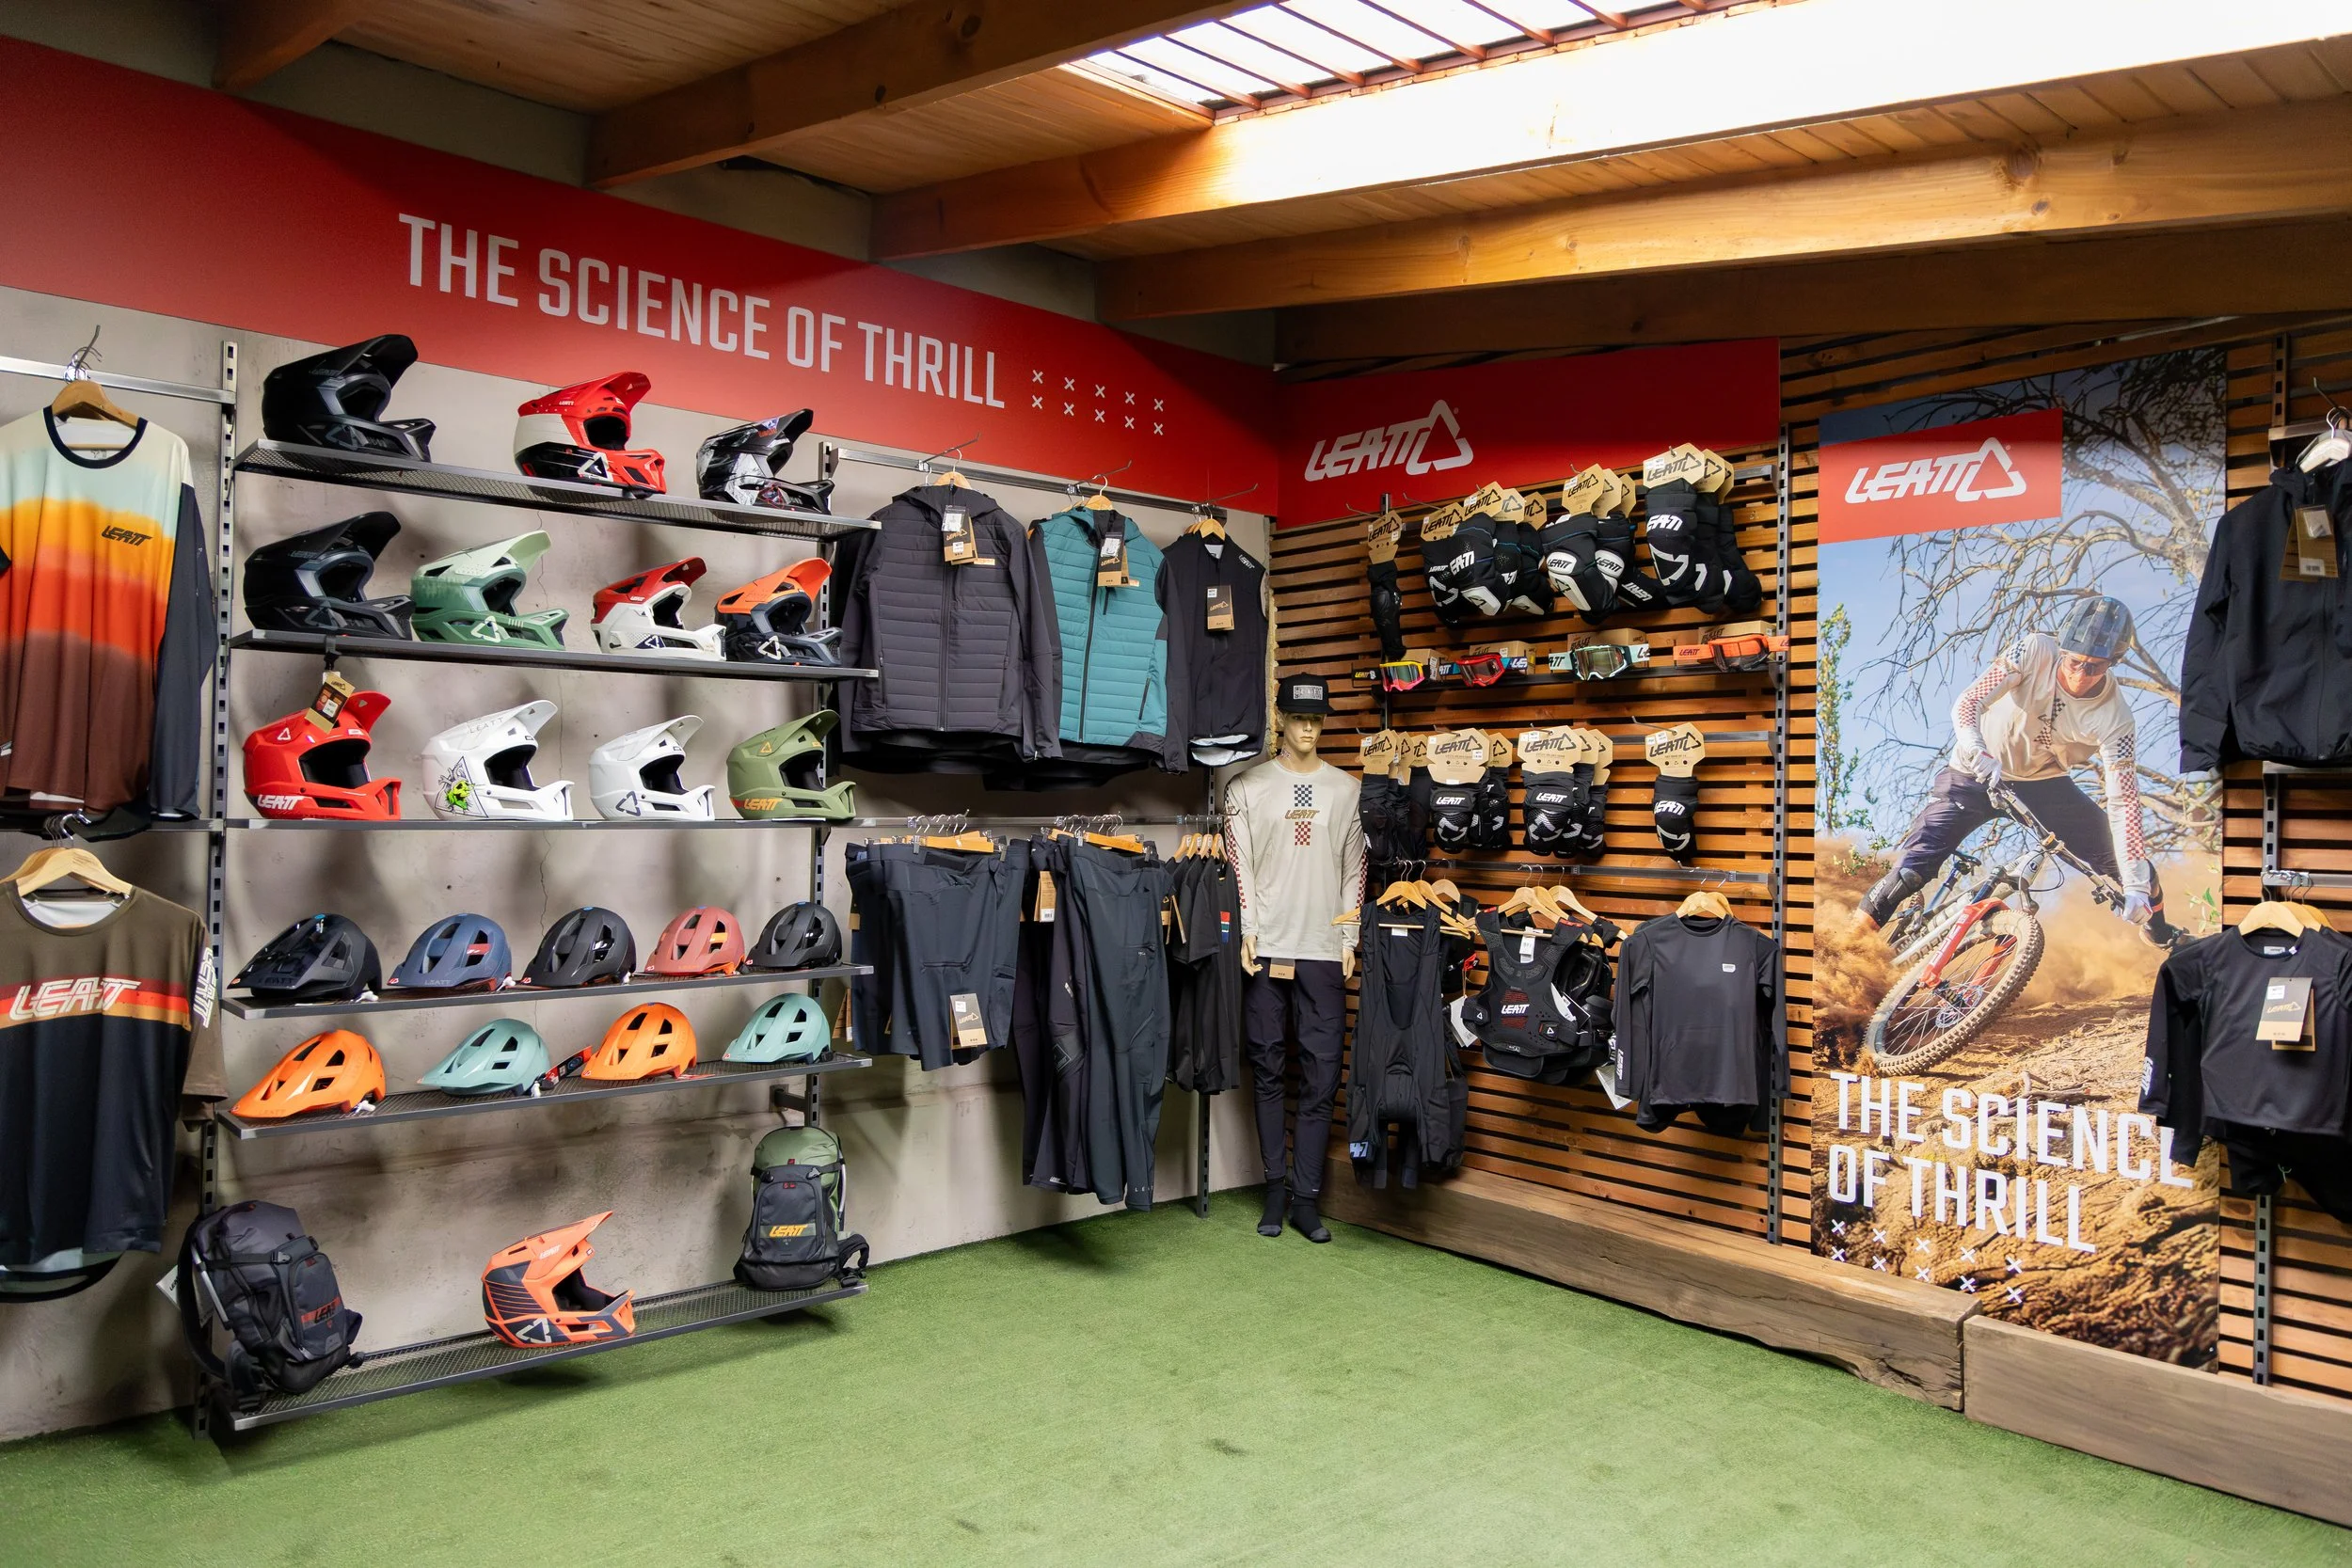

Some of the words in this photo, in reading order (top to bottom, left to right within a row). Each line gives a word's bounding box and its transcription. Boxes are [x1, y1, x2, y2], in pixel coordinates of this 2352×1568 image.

[399, 213, 518, 308] THE
[539, 248, 770, 360] SCIENCE
[787, 306, 846, 372] OF
[857, 322, 1005, 408] THRILL
[1305, 414, 1437, 482] LEATT
[1646, 457, 1689, 482] LEATT
[1845, 449, 1985, 503] LEATT
[1567, 477, 1592, 498] LEATT
[1465, 494, 1492, 516] LEATT
[1368, 519, 1393, 543] LEATT
[1423, 513, 1454, 534] LEATT
[1646, 514, 1683, 531] EATT
[101, 525, 152, 546] LEATT
[1449, 550, 1475, 576] EATT
[1548, 559, 1573, 569] LEATT
[1596, 557, 1624, 572] LEATT
[1679, 648, 1700, 657] LEATT
[1549, 657, 1565, 667] ATT
[1364, 738, 1385, 757] LEATT
[1435, 737, 1470, 755] LEATT
[1525, 736, 1563, 753] LEATT
[1649, 735, 1690, 757] LEATT
[258, 795, 304, 810] LEATT
[743, 798, 783, 811] LEATT
[1436, 797, 1466, 805] LEATT
[1535, 792, 1568, 802] LEATT
[1285, 809, 1319, 819] LEATT
[1501, 1004, 1530, 1014] LEATT
[1830, 1070, 1926, 1143] THE
[1829, 1144, 1890, 1208] OF
[1902, 1155, 2096, 1253] THRILL
[769, 1224, 809, 1238] LEATT
